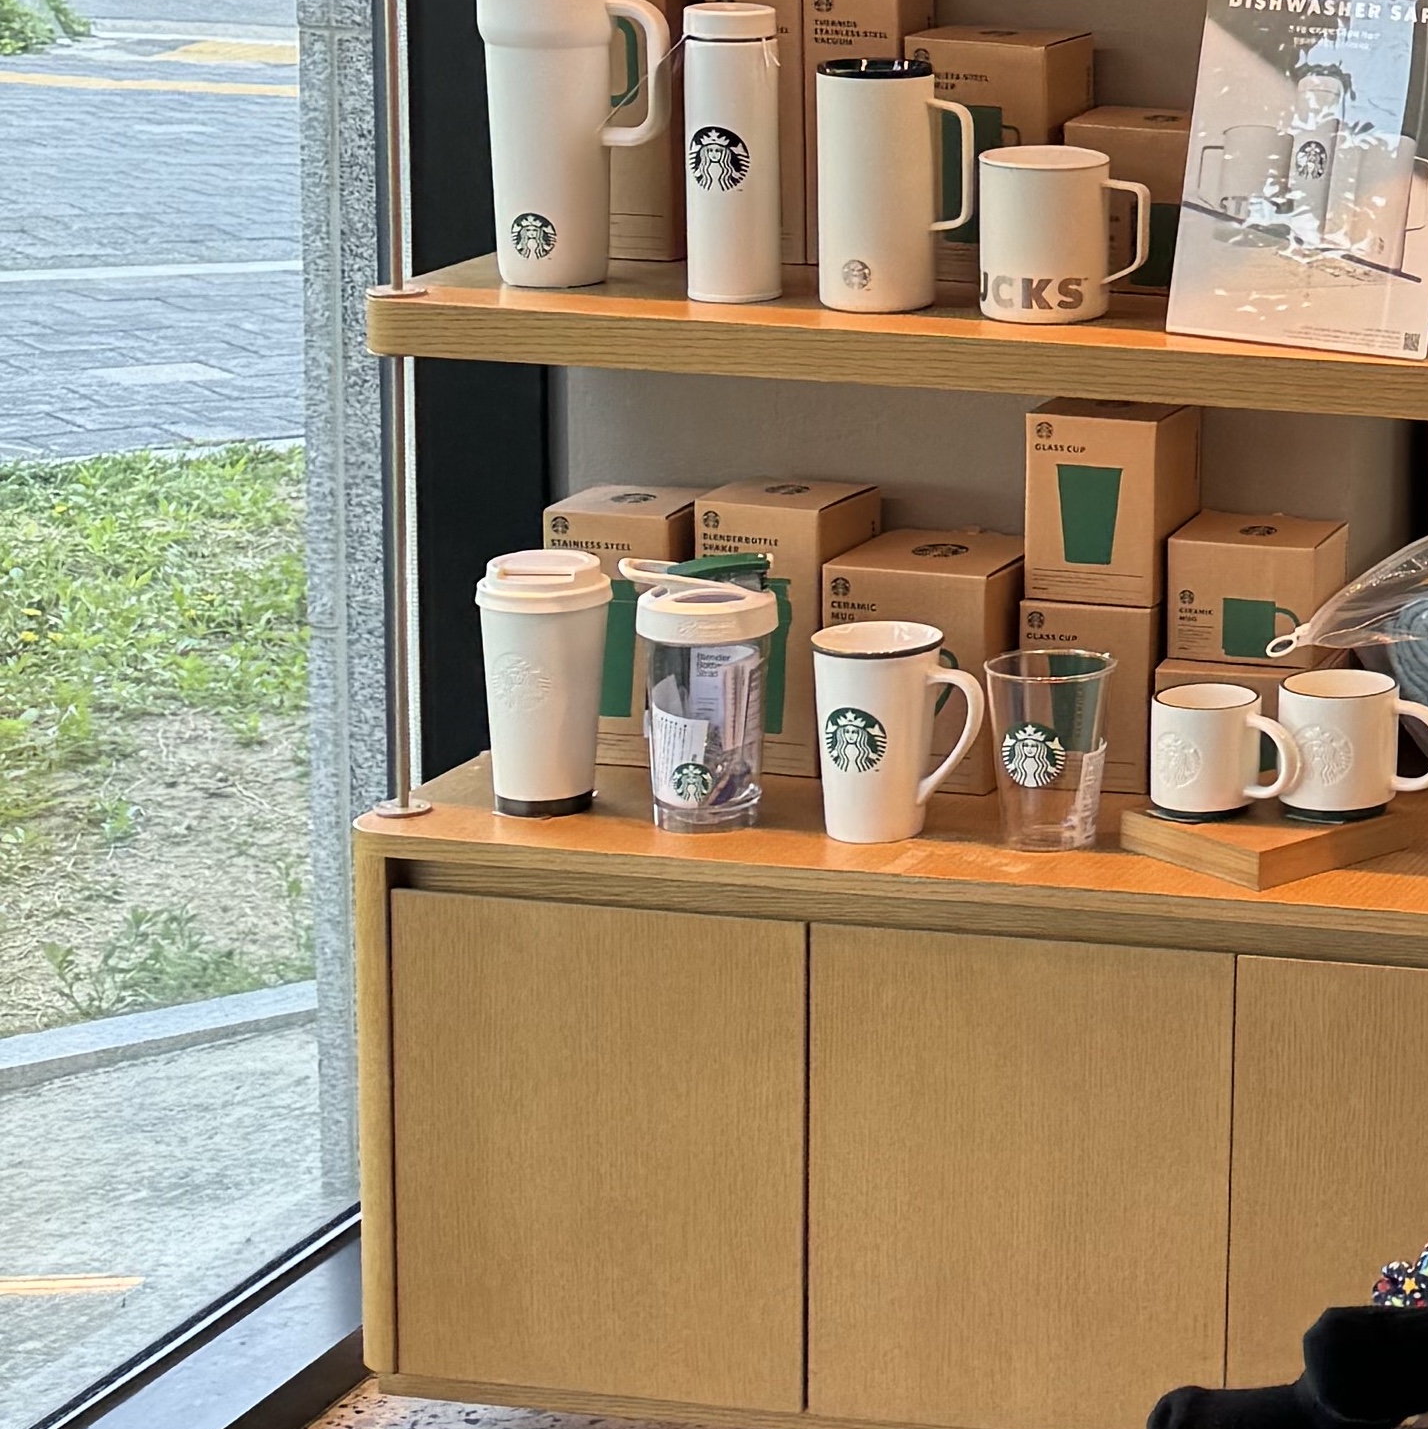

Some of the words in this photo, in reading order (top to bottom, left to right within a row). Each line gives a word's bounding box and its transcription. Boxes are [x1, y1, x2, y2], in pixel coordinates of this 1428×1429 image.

[1035, 443, 1064, 452] GLASS
[1066, 445, 1086, 453] CUP
[551, 539, 601, 550] STAINLESS
[604, 542, 632, 551] STEEL
[831, 601, 877, 612] CERAMIC
[831, 612, 855, 621] MUG
[1026, 633, 1056, 641] GLASS
